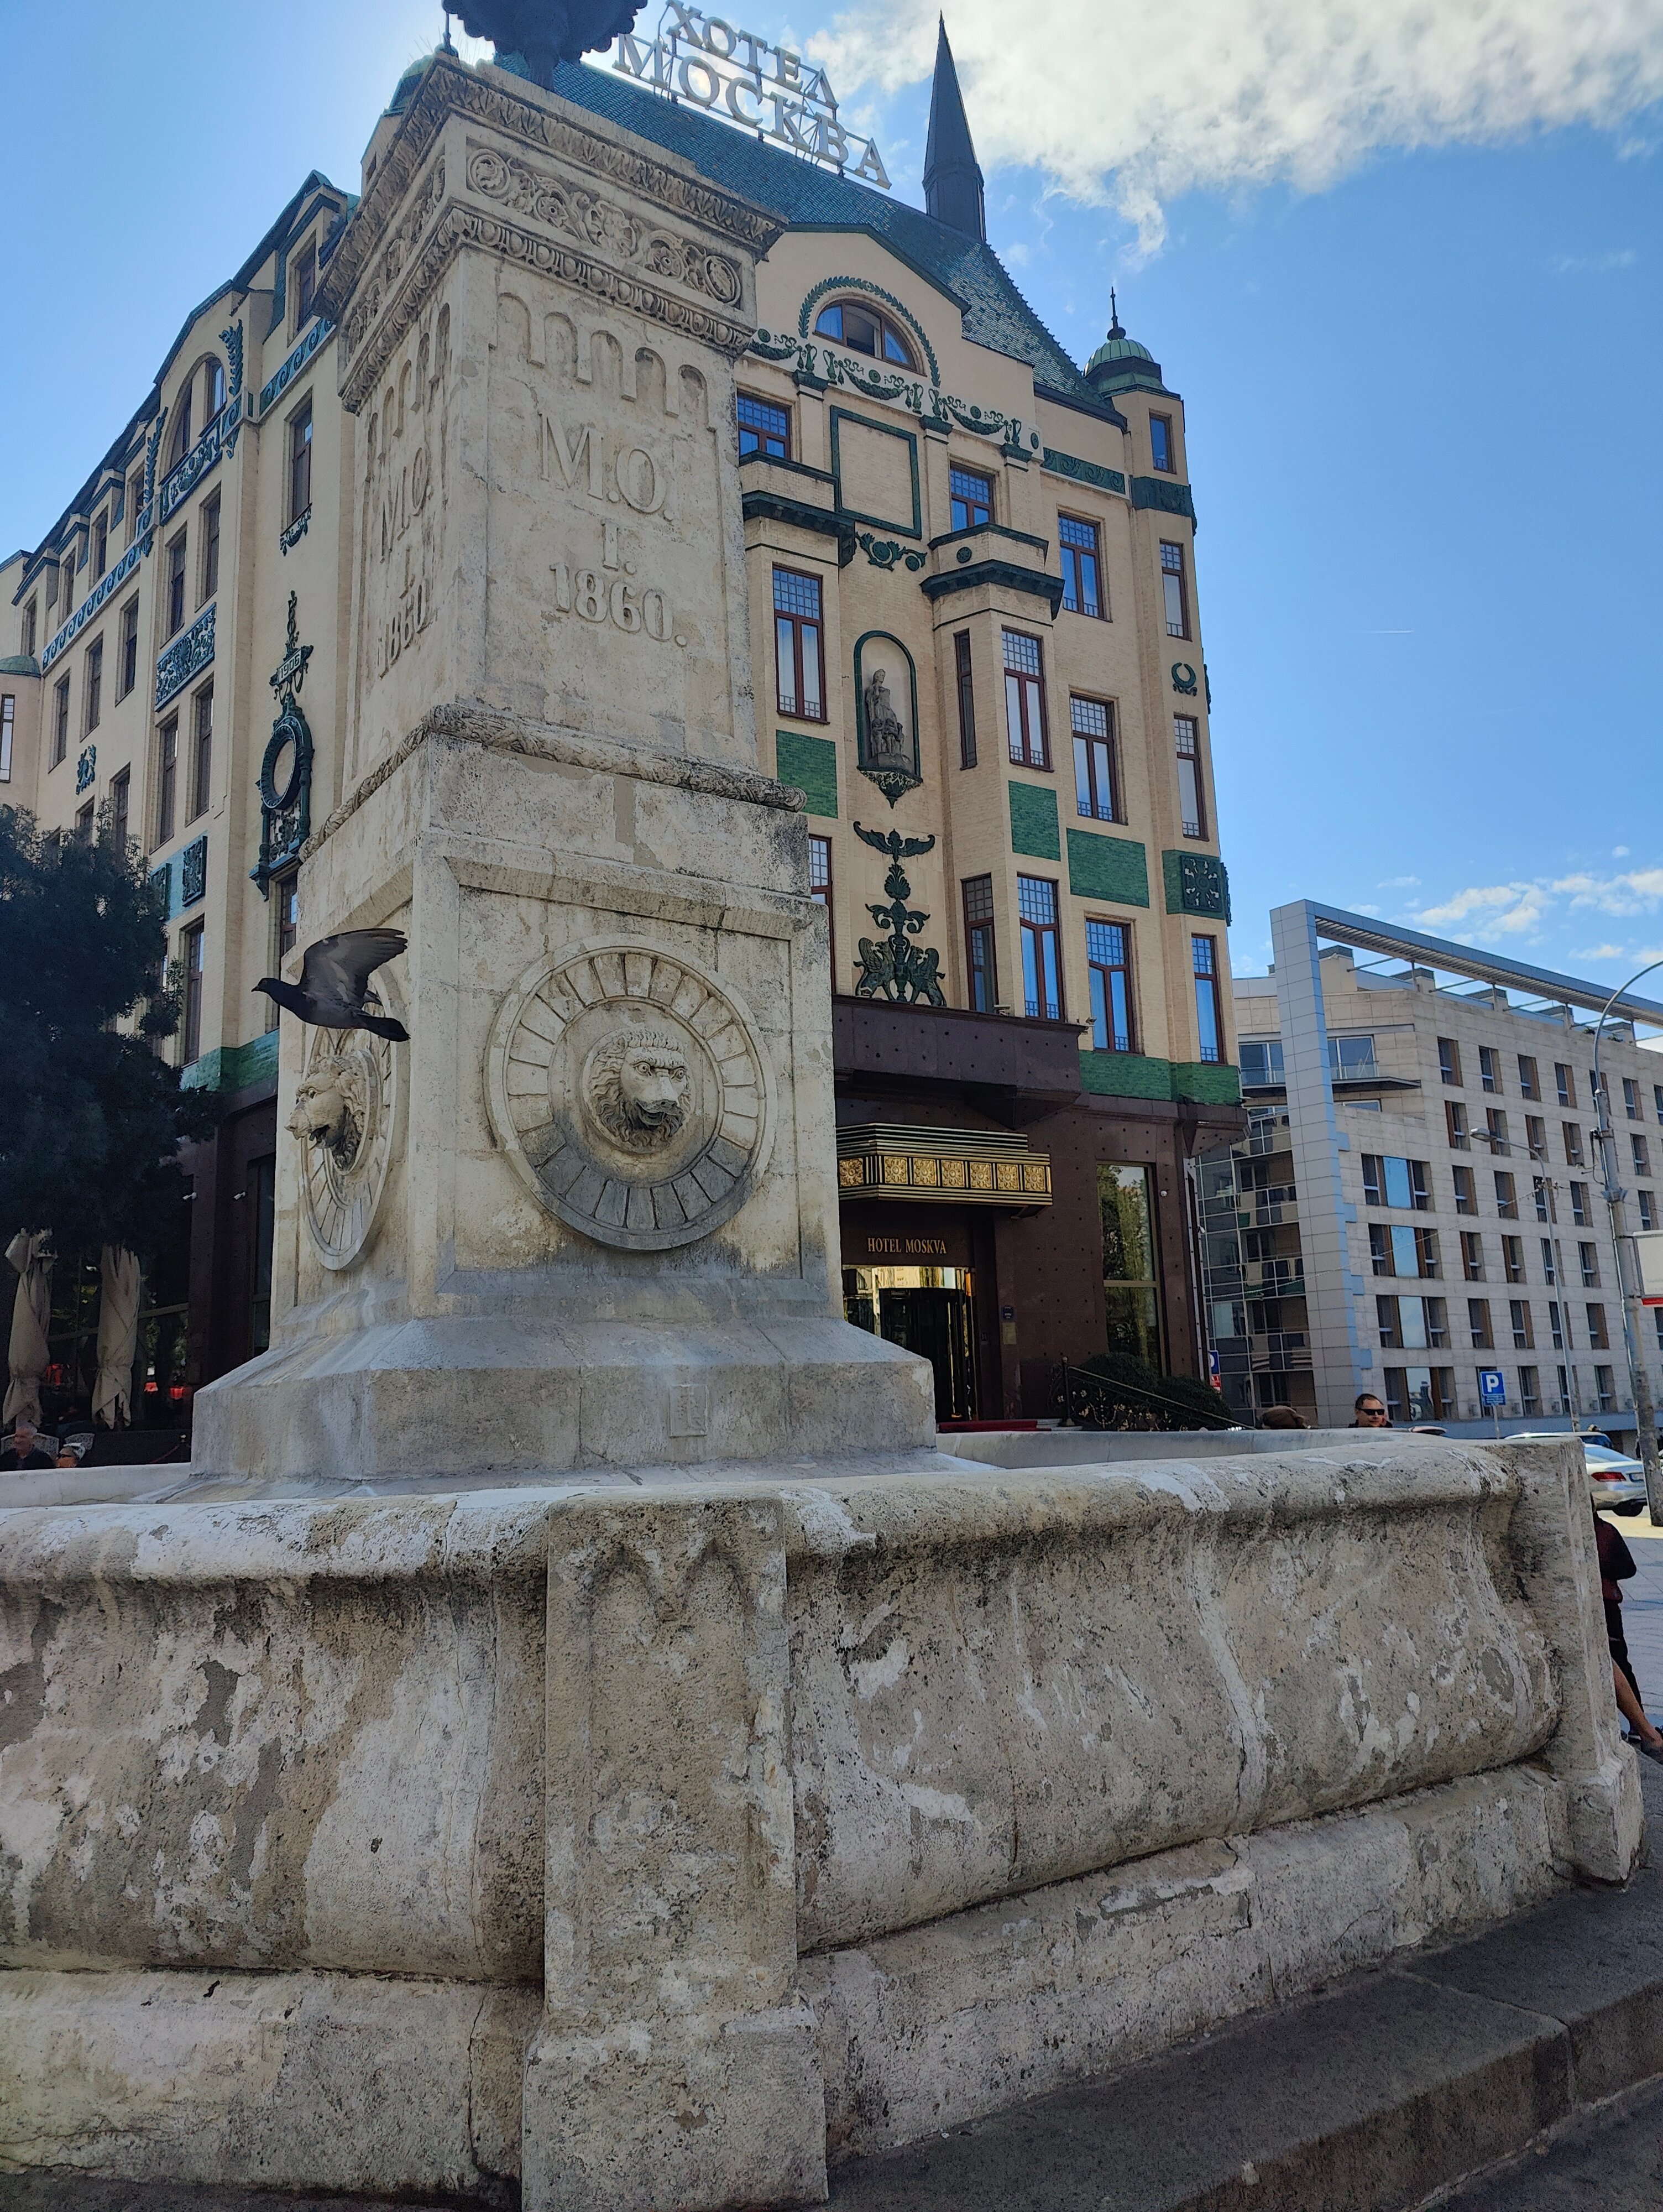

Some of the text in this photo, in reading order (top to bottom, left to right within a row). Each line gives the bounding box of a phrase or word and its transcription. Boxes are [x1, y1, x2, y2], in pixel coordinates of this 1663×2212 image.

[612, 33, 892, 189] МОСКВА
[867, 1238, 946, 1254] HOTEL MOSKVA
[1486, 1374, 1499, 1393] P
